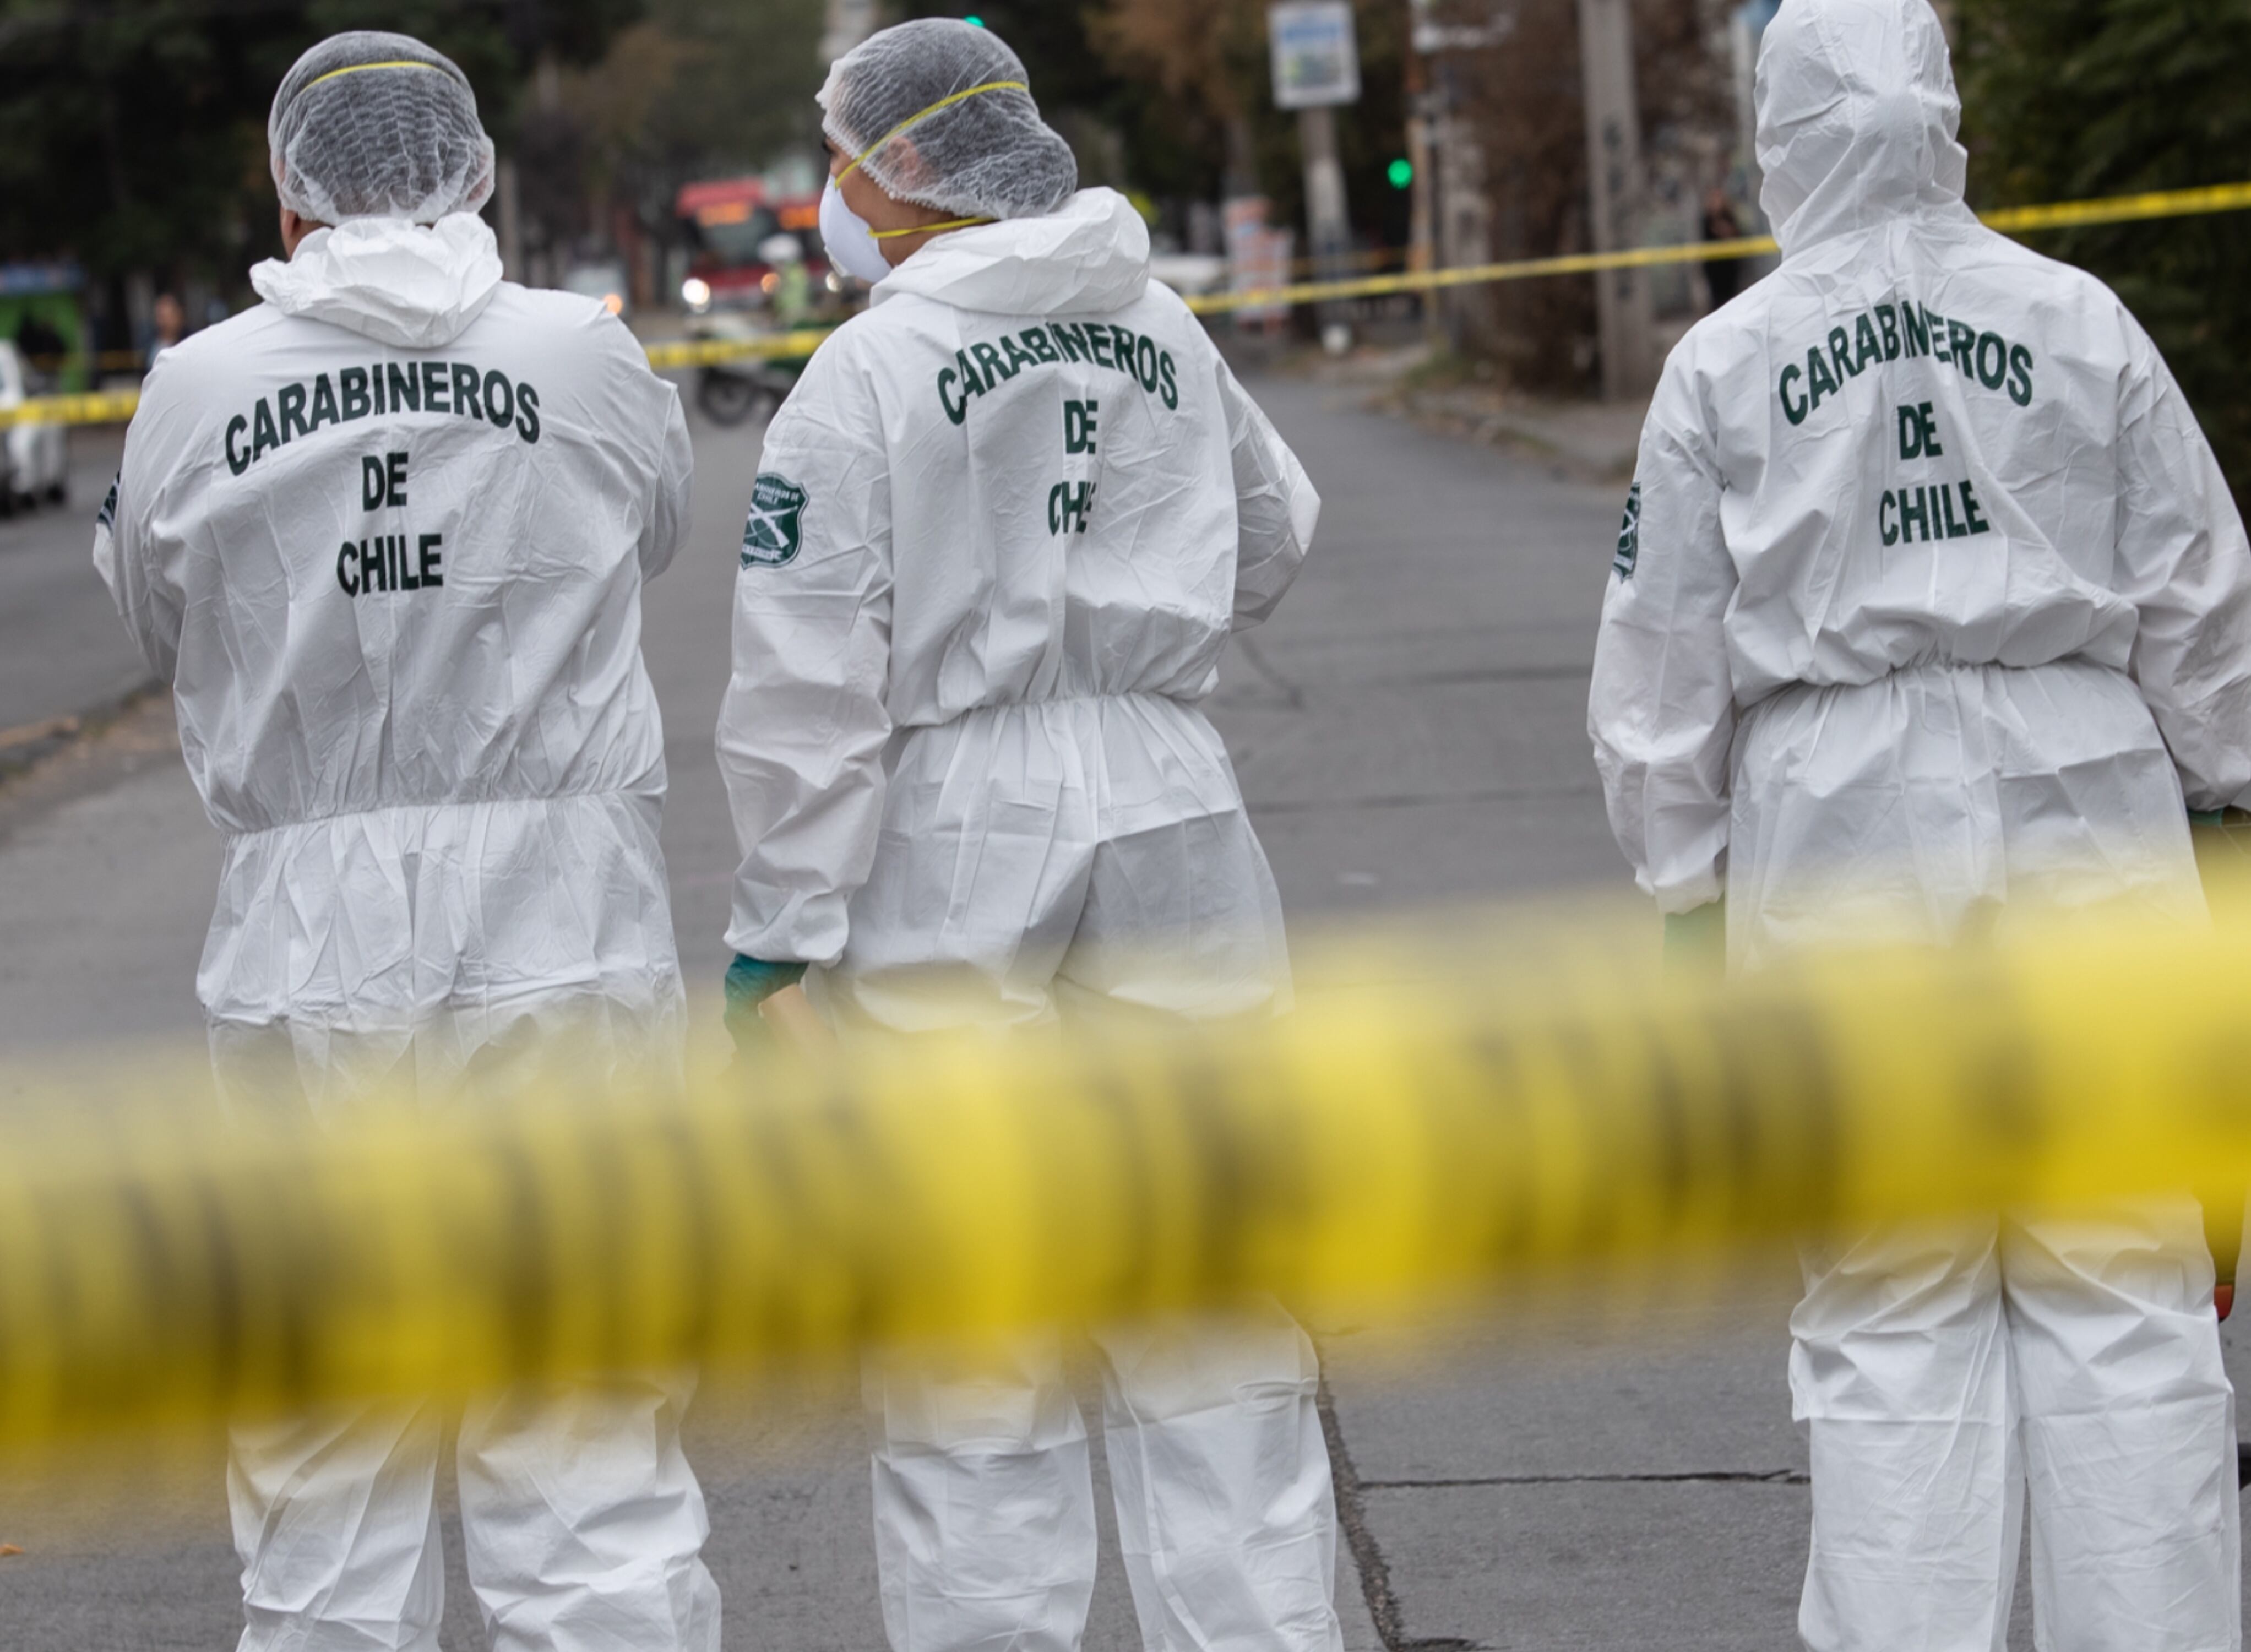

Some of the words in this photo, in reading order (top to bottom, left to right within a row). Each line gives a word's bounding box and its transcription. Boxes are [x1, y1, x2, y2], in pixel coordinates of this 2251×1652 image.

[937, 322, 1178, 426] CARABINEROS
[1779, 300, 2033, 426] CARABINEROS
[225, 361, 540, 476] CARABINEROS
[1063, 400, 1098, 454] DE
[1897, 401, 1943, 460] DE
[361, 451, 409, 512] DE
[1879, 480, 1990, 546] CHILE
[336, 533, 443, 597] CHILE
